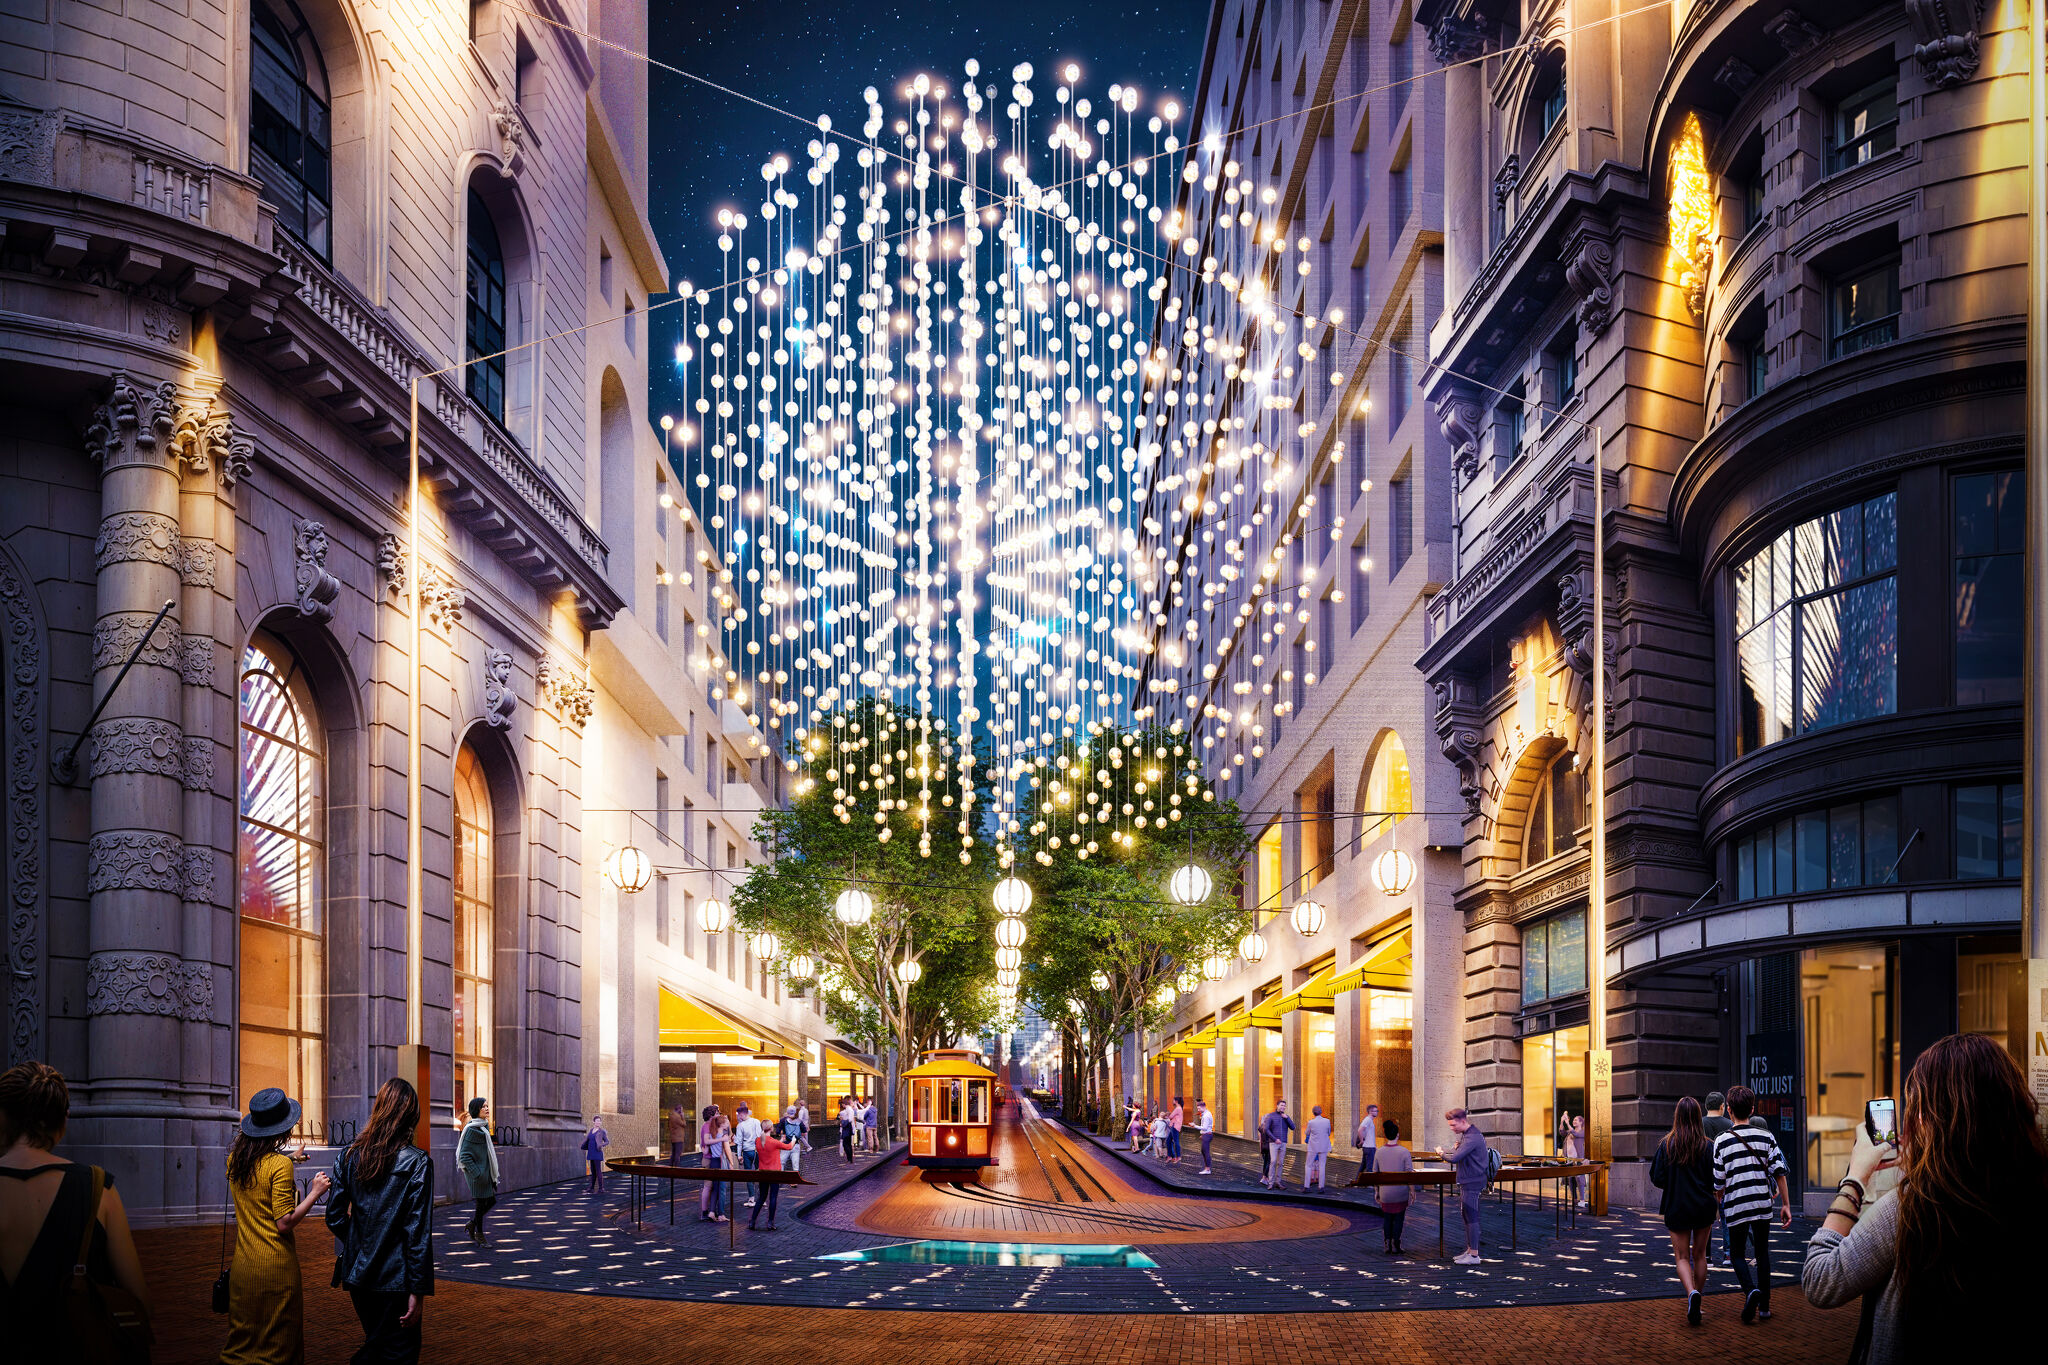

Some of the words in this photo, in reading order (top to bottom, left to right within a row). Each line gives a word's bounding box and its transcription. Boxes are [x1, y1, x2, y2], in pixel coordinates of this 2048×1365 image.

[1751, 1056, 1767, 1074] IT'S
[1751, 1077, 1769, 1095] NOT
[1771, 1076, 1793, 1094] JUST
